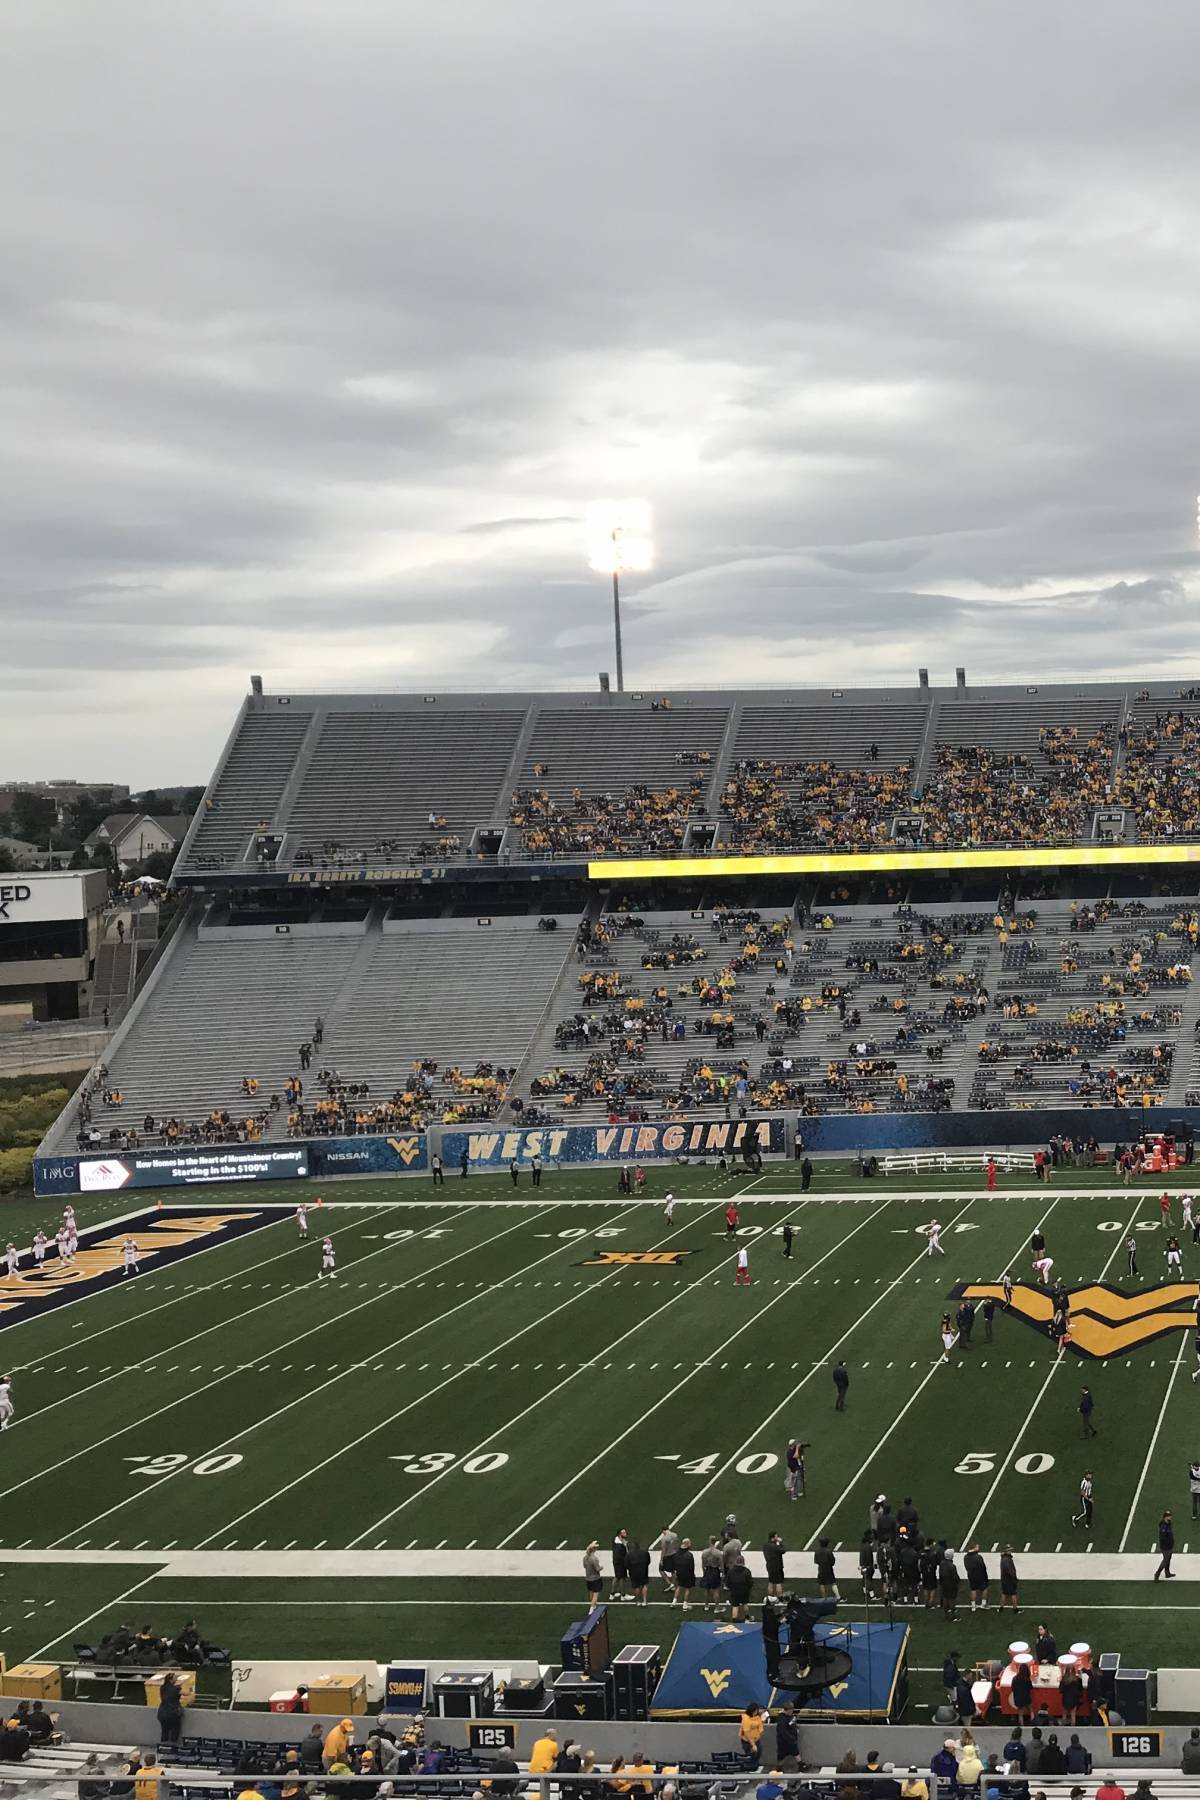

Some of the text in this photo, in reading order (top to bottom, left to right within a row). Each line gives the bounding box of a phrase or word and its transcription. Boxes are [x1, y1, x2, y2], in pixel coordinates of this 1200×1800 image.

[431, 869, 446, 878] 21
[468, 1122, 771, 1160] WEST VIRGINIA
[152, 1160, 176, 1168] Homes
[186, 1158, 198, 1166] the
[327, 1152, 369, 1162] NISSAN
[42, 1166, 75, 1180] IMG
[172, 1168, 210, 1177] Starting
[210, 1166, 220, 1175] in
[220, 1166, 236, 1174] the
[1096, 1220, 1162, 1232] 50
[129, 1453, 245, 1475] 20
[403, 1452, 510, 1474] 30
[676, 1452, 779, 1475] 40
[953, 1453, 1057, 1476] 50
[275, 1702, 286, 1712] G
[478, 1729, 506, 1745] 125
[1122, 1737, 1151, 1753] 126
